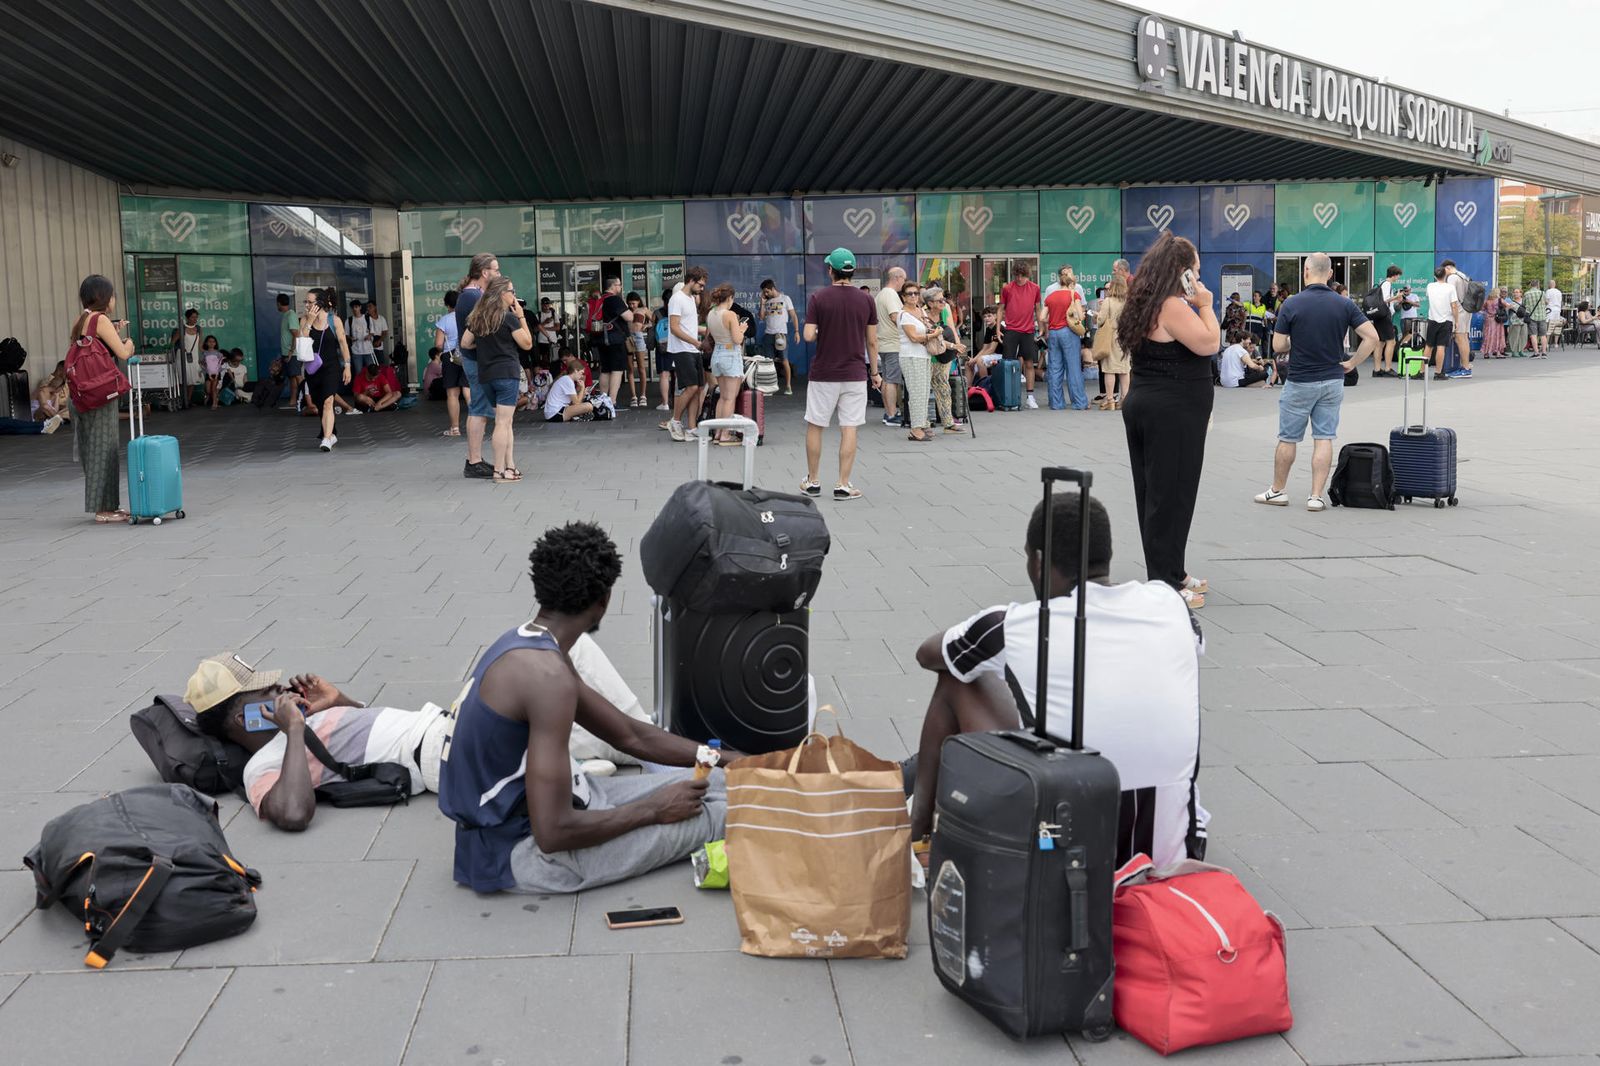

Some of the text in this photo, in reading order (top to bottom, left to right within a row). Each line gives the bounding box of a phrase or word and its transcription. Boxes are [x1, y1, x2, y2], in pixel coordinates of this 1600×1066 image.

[1179, 27, 1306, 115] VALÈNCIA
[1405, 93, 1475, 154] SOROLLA
[1050, 272, 1112, 282] Babas un
[205, 298, 229, 310] has
[425, 296, 445, 308] tre
[142, 316, 225, 329] encoado
